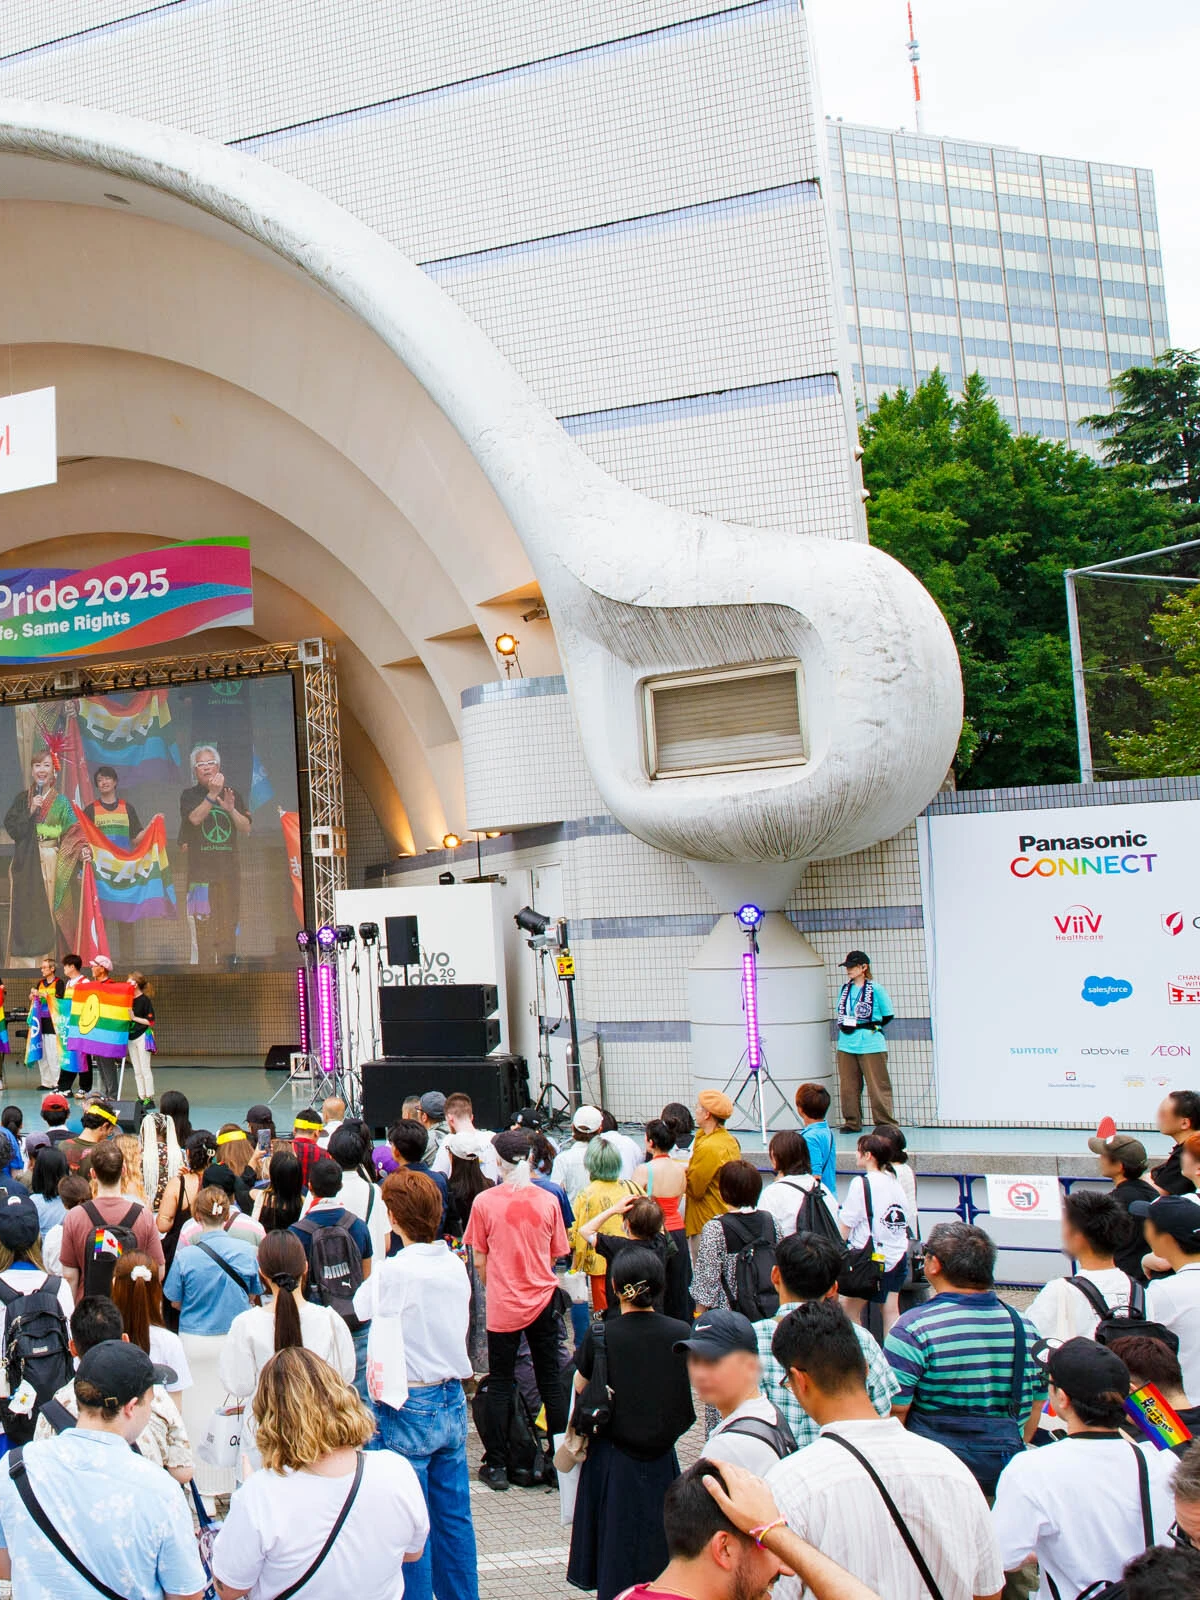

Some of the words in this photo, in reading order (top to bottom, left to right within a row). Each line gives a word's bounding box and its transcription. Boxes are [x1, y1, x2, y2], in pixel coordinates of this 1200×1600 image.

[84, 568, 169, 607] 2025
[21, 620, 70, 638] Same
[74, 612, 130, 632] Rights
[1019, 830, 1147, 852] Panasonic
[1010, 854, 1158, 878] CONNECT
[1054, 914, 1102, 934] ViiV
[380, 968, 438, 986] Prde
[440, 968, 455, 977] 20
[1088, 986, 1128, 995] salesforce
[1081, 1047, 1129, 1055] abbvie
